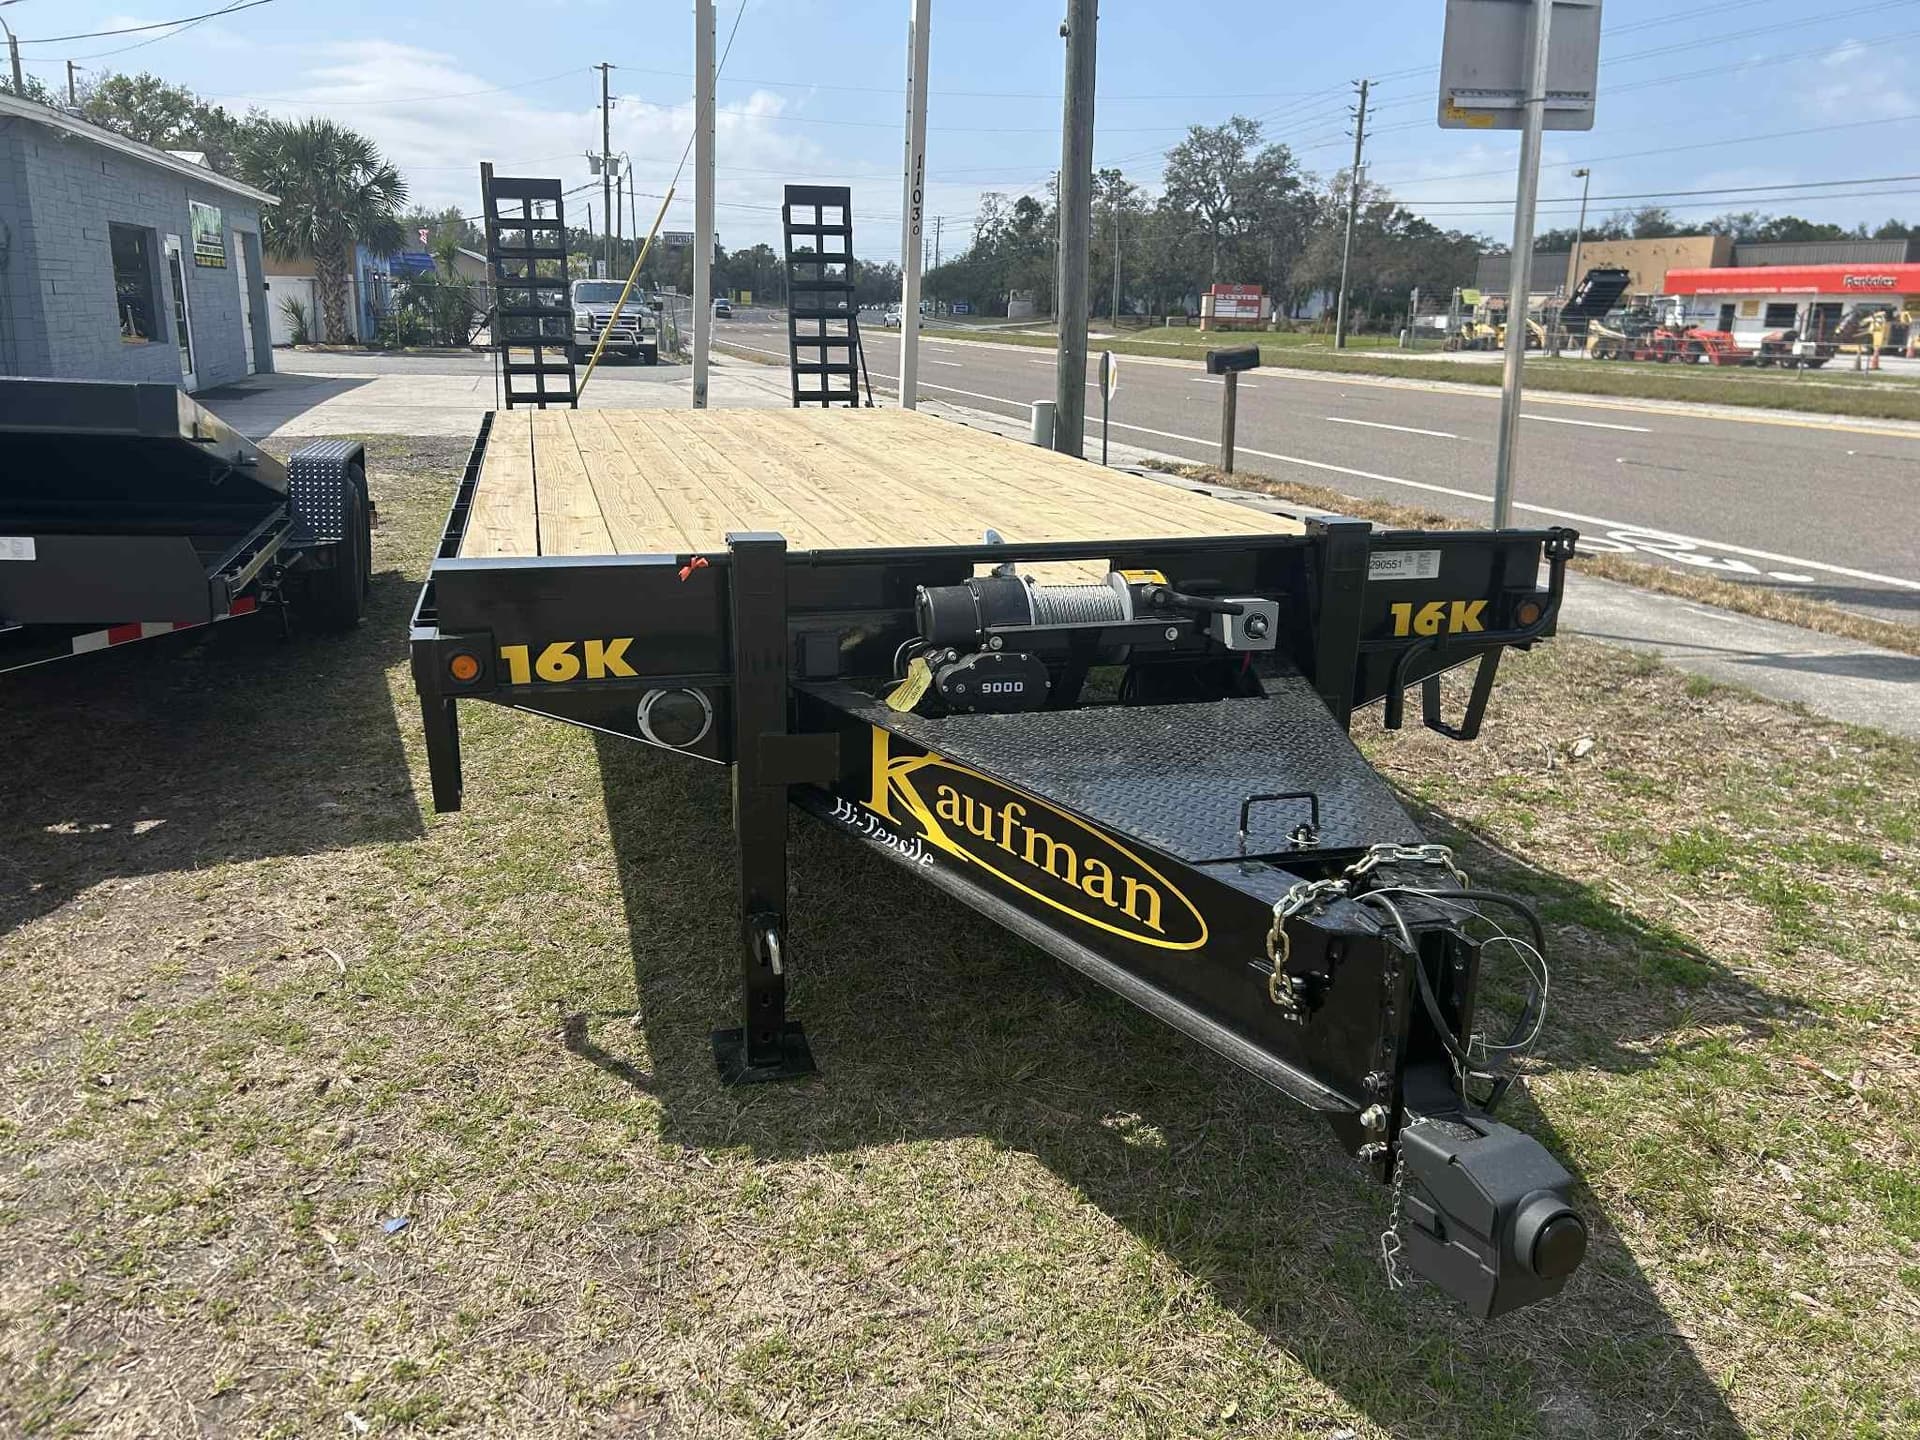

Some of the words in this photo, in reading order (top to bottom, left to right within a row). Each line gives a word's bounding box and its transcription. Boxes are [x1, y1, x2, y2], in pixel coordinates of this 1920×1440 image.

[911, 153, 922, 235] 11030
[1391, 600, 1488, 637] 16K
[500, 637, 640, 685] 16K
[982, 681, 1024, 693] 9000
[828, 797, 934, 867] Hi-Tensile
[859, 724, 1166, 934] Kaufman
